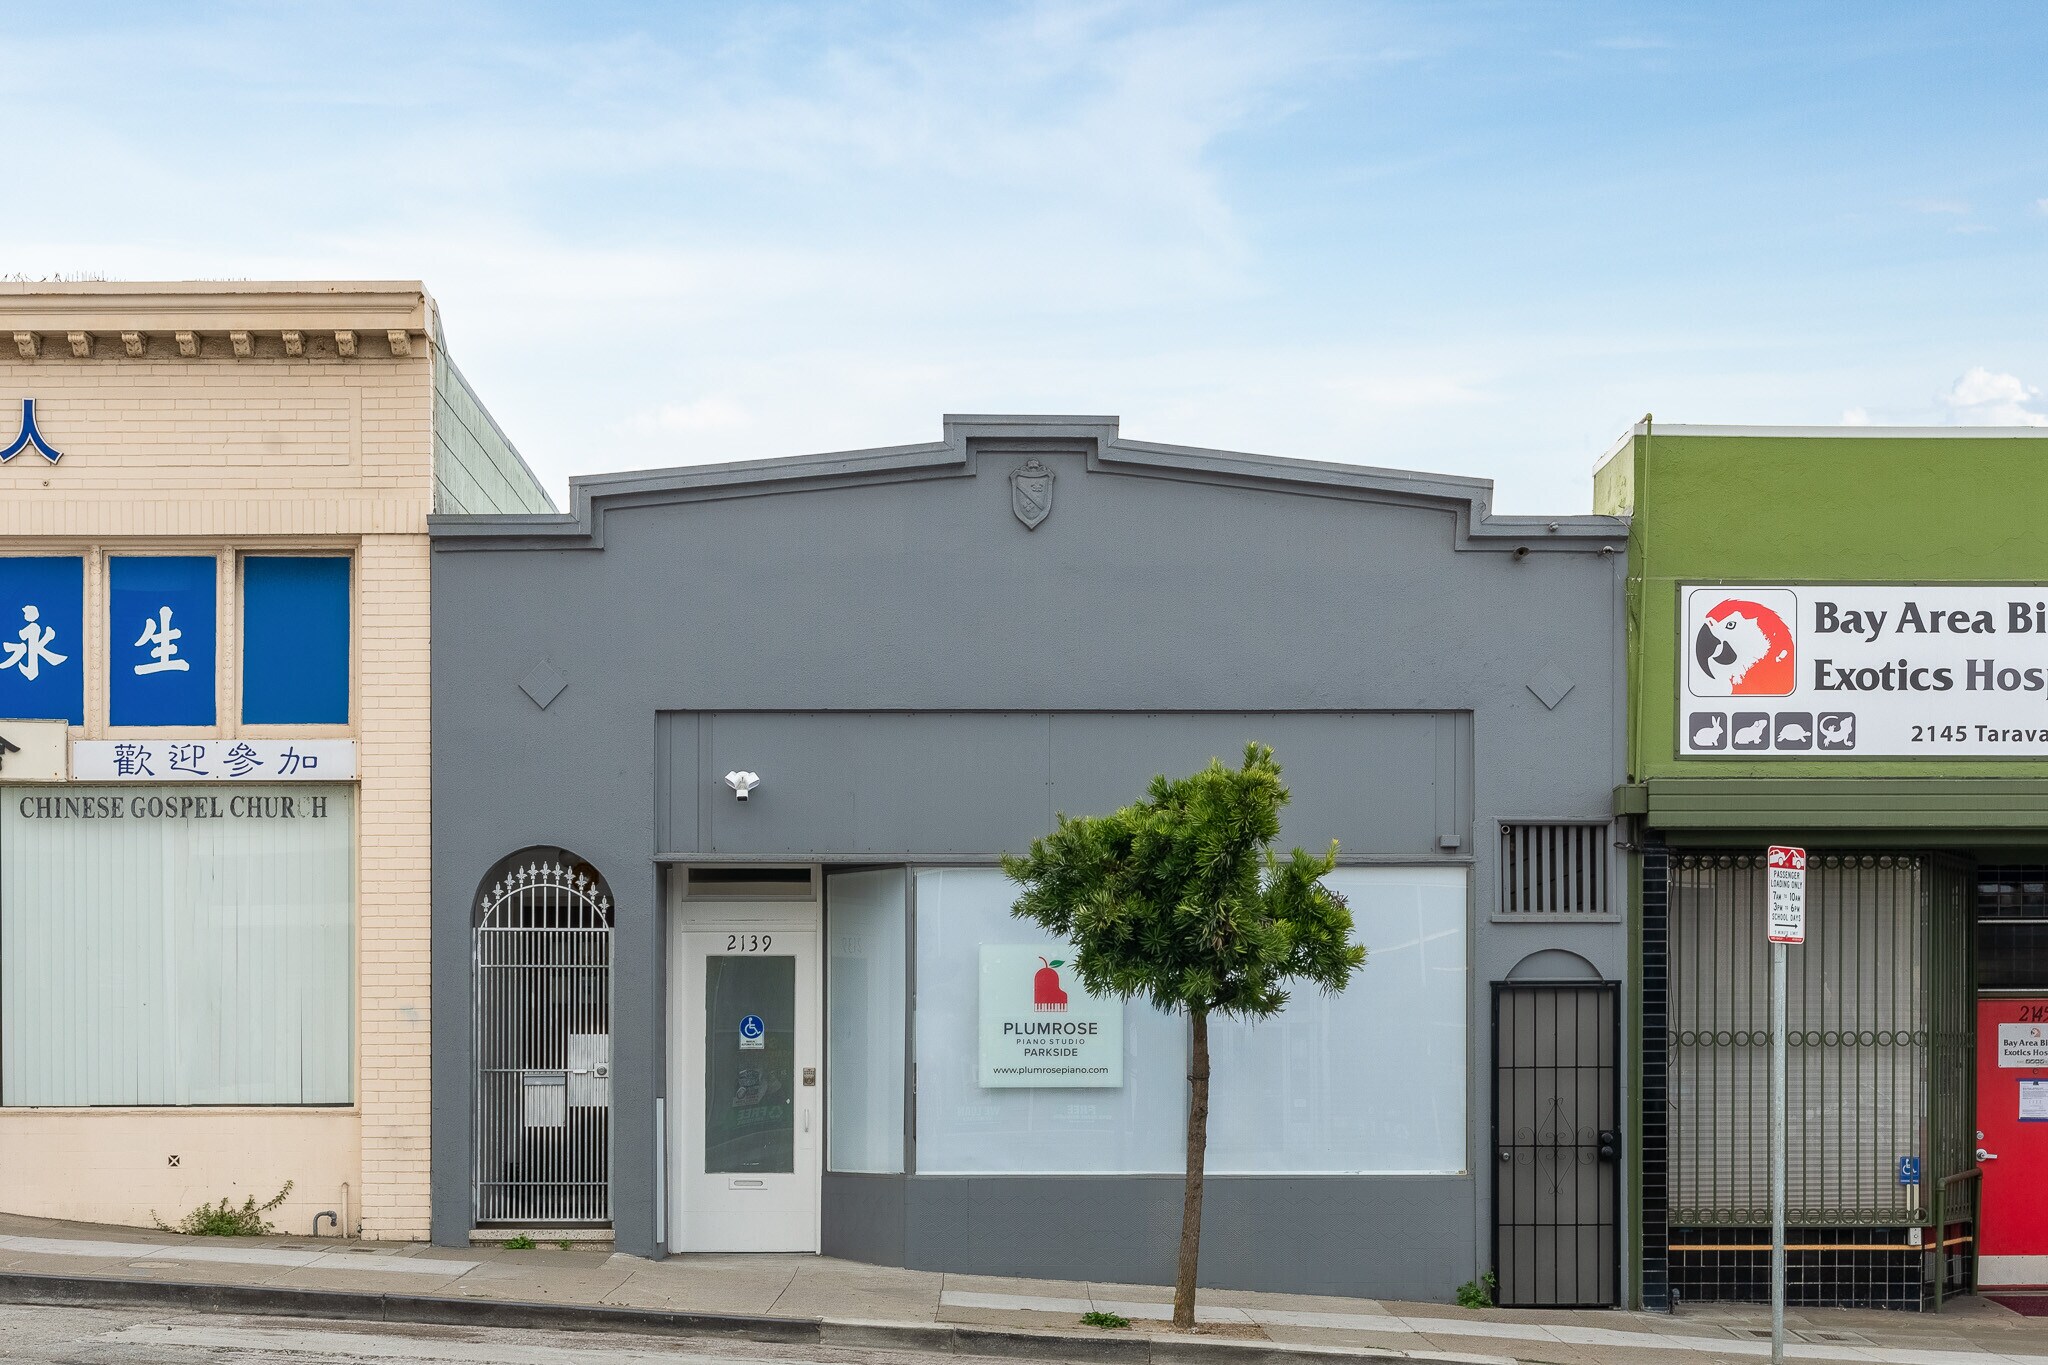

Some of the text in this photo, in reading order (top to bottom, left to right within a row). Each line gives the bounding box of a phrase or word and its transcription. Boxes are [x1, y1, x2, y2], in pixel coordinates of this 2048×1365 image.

[1814, 601, 2047, 642] Bay Area Bi
[1813, 659, 2048, 701] Exotics Hos
[1911, 724, 2048, 742] 2145 Tarava
[113, 742, 318, 777] 歡迎參加
[19, 796, 124, 819] CHINESE
[131, 796, 224, 819] GOSPEL
[1773, 870, 1800, 879] PASSENGER
[1771, 880, 1803, 889] LOADING ONLY
[727, 935, 772, 952] 2139
[1003, 1022, 1098, 1035] PLUMROSE
[2003, 1039, 2018, 1048] Bay
[2019, 1039, 2039, 1047] Area
[1024, 1048, 1078, 1057] PARKSIDE
[993, 1066, 1109, 1075] www.plumrosepiano.com
